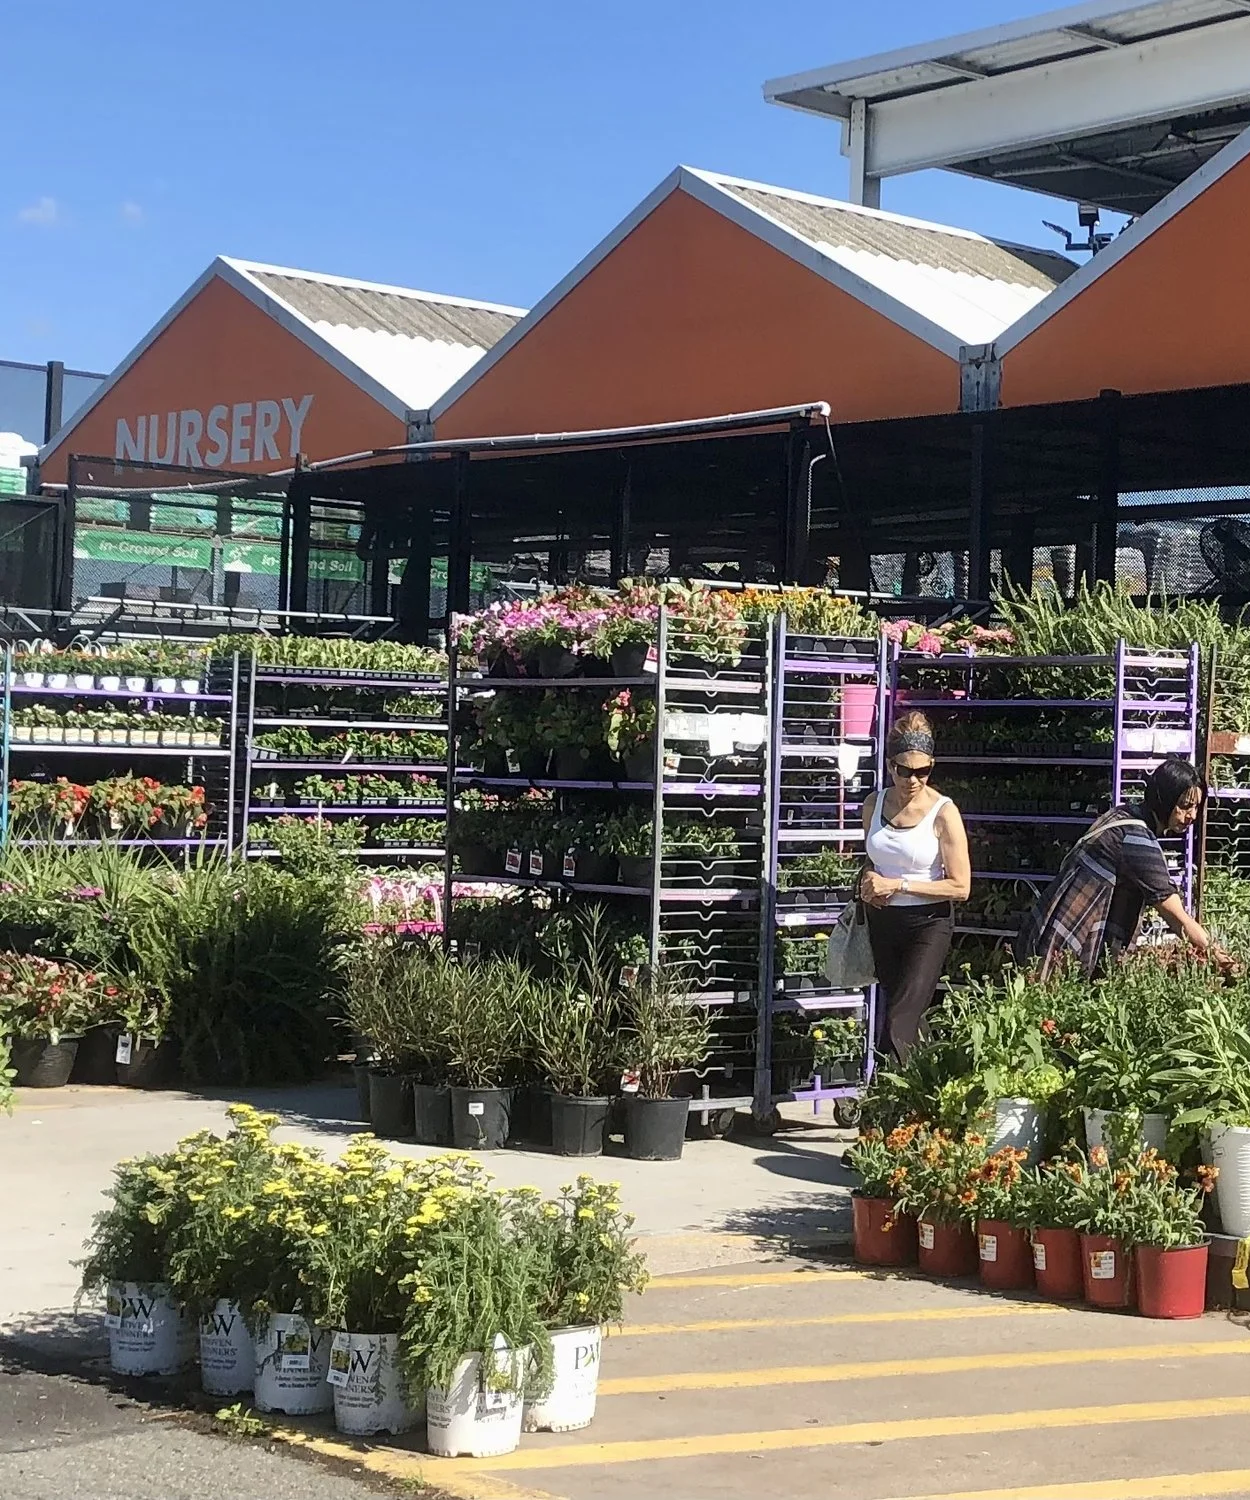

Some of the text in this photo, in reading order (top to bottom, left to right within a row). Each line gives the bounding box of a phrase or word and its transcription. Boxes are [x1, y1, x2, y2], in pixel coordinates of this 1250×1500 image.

[114, 395, 315, 475] NURSERY
[172, 546, 200, 559] Soil
[329, 560, 353, 572] Soil
